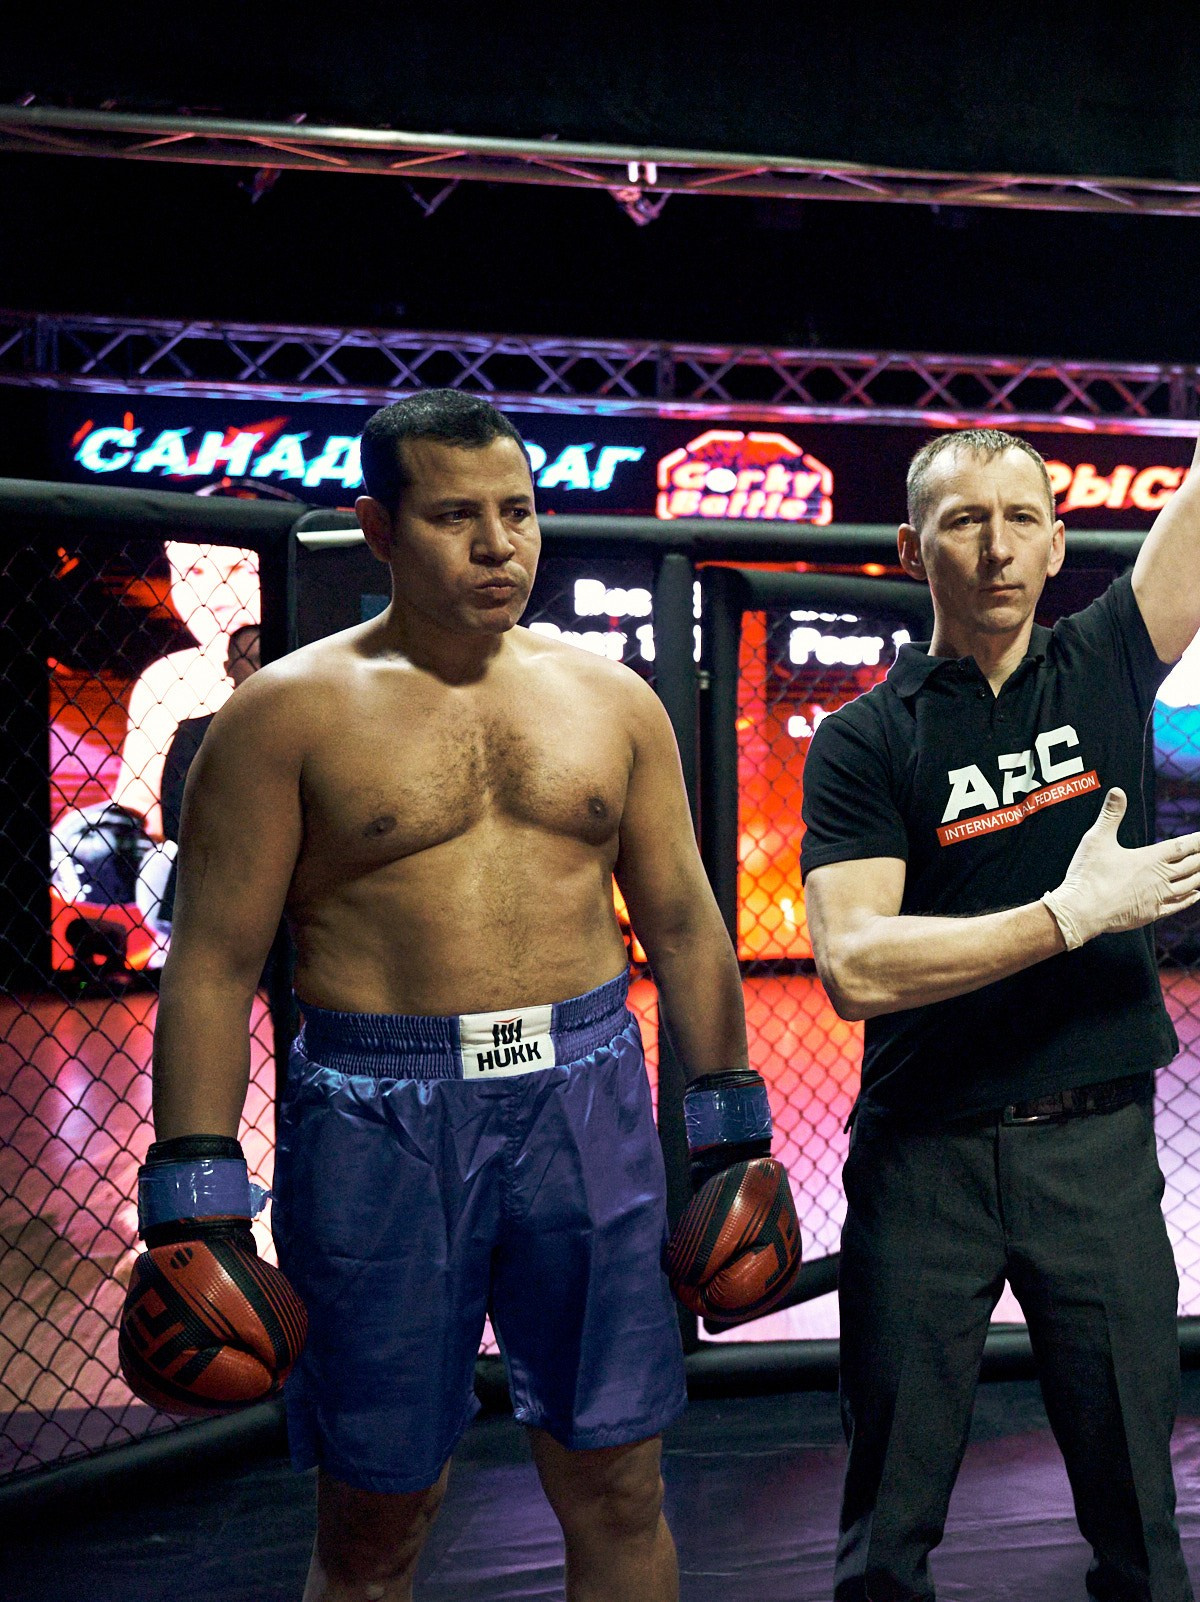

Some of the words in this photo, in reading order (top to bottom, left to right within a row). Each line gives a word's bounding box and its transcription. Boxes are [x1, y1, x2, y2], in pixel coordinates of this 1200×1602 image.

[668, 489, 808, 520] Battle
[941, 724, 1085, 823] ARC
[945, 799, 1036, 840] INTERNATIONAL
[1034, 775, 1096, 806] FEDERATION
[477, 1041, 542, 1072] HUKK
